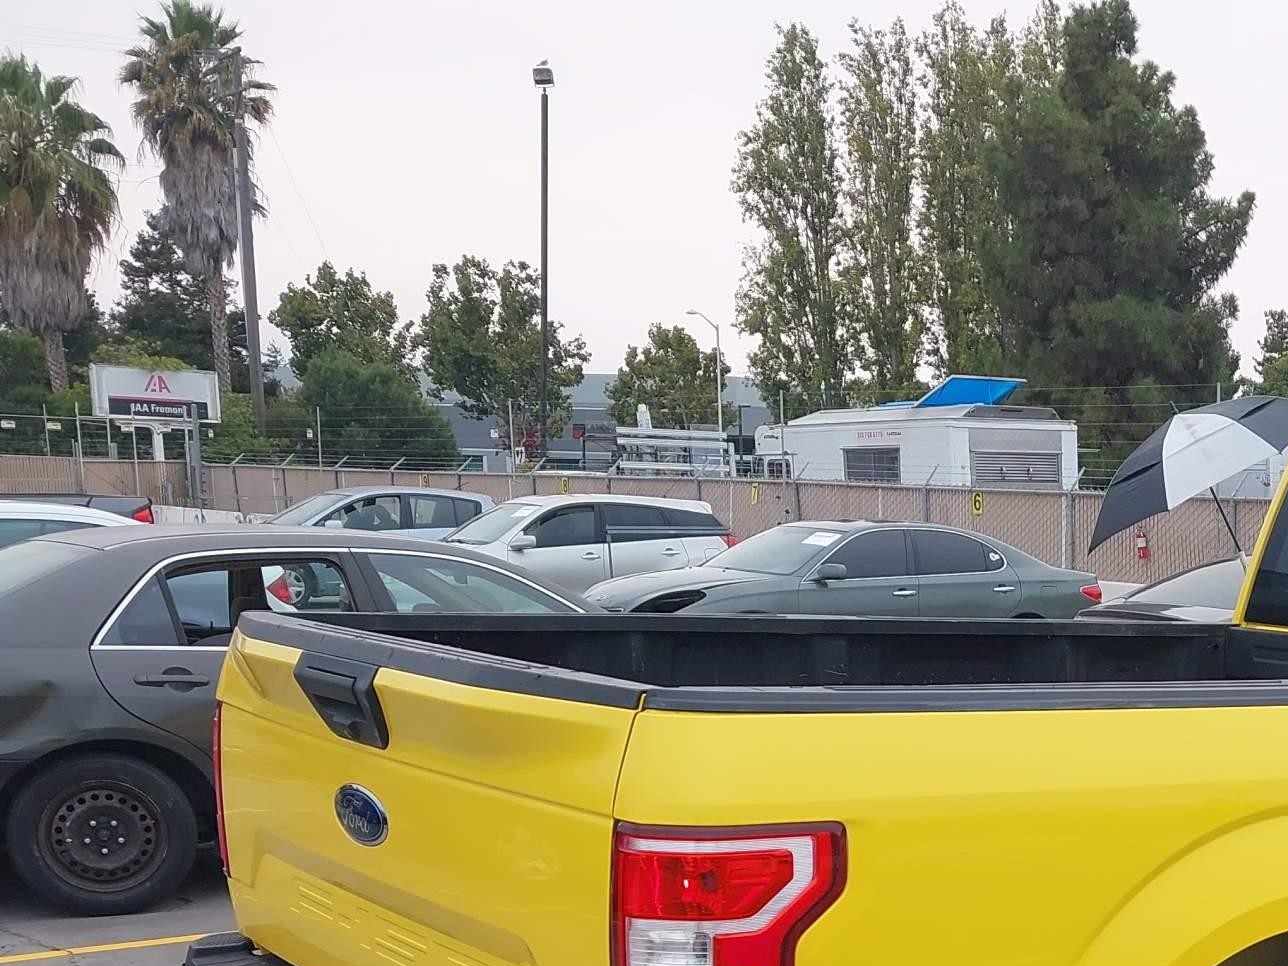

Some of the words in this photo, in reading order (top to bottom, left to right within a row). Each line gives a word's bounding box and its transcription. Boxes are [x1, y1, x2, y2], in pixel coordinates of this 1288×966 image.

[151, 403, 185, 414] Fremon
[752, 485, 758, 502] 7
[973, 493, 981, 511] 6
[341, 796, 370, 833] Ford
